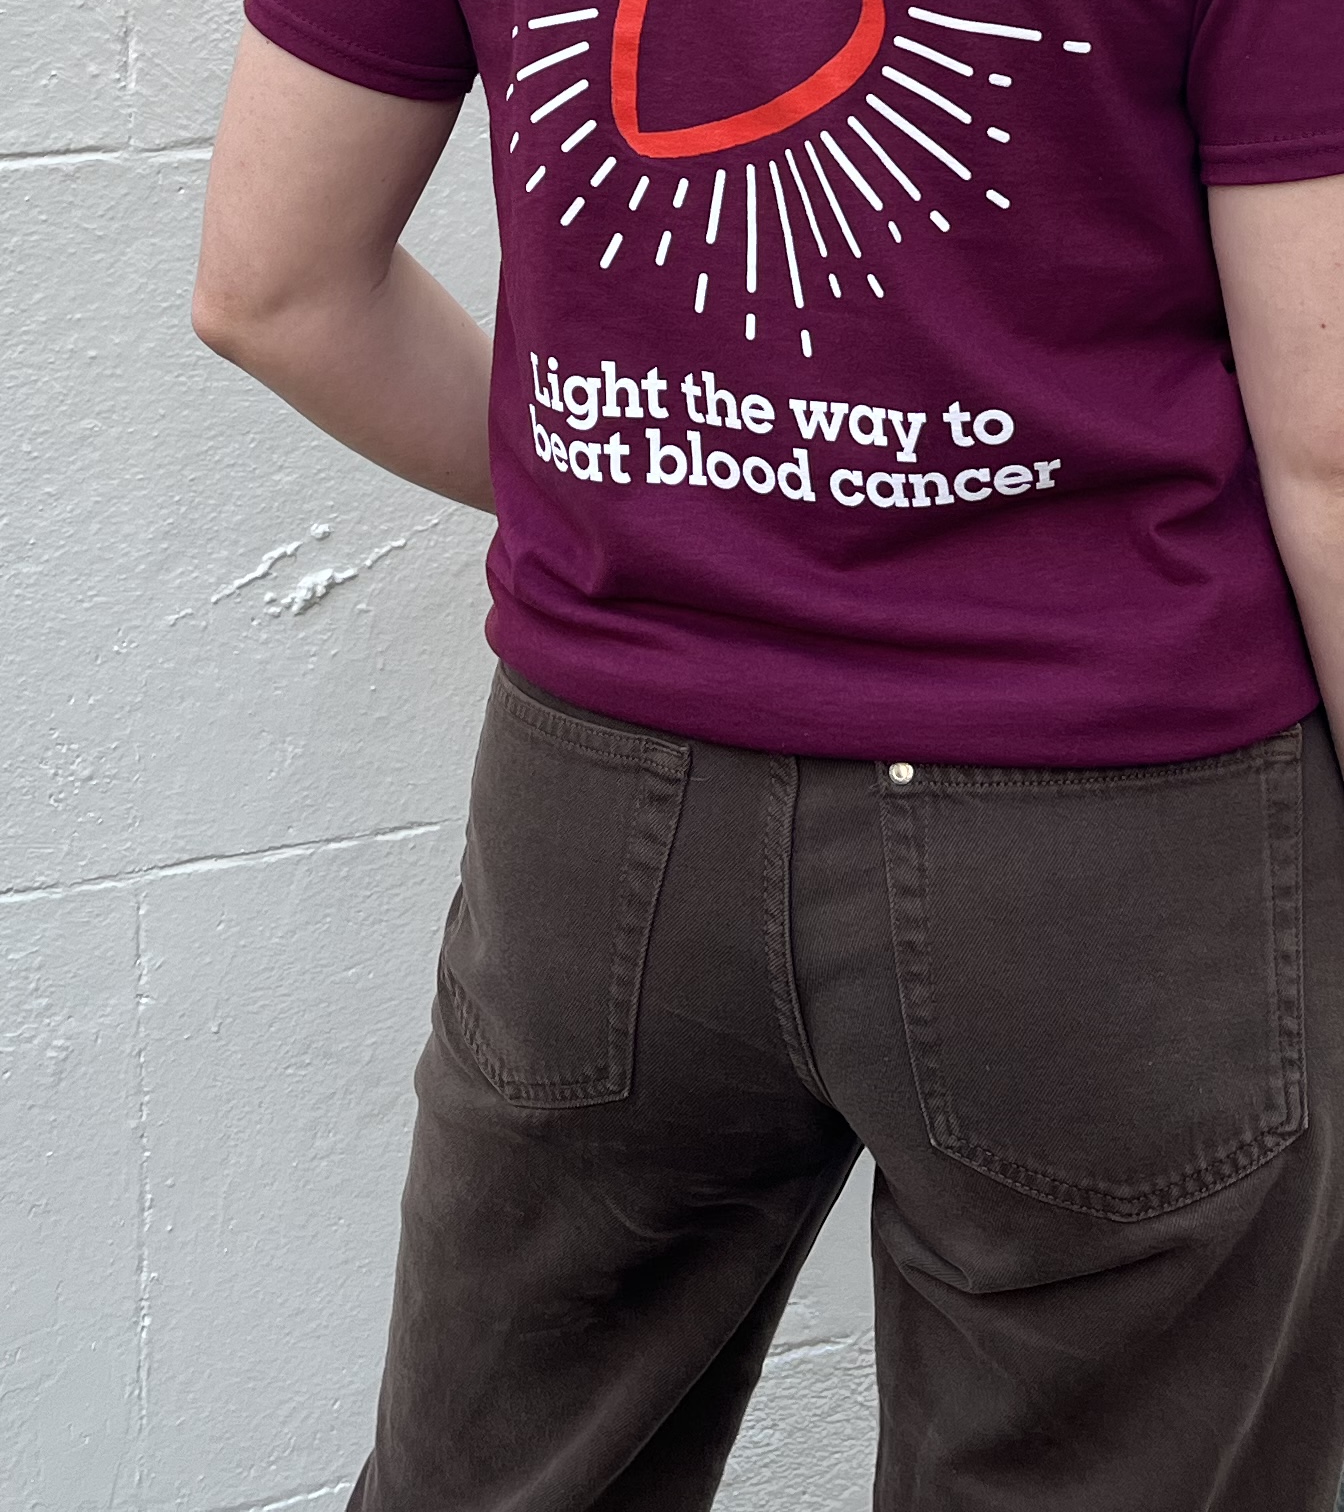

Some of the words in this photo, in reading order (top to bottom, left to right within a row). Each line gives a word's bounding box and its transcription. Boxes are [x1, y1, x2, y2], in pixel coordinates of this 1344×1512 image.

[529, 352, 668, 430] Light
[681, 371, 775, 434] the
[789, 398, 926, 463] way
[942, 401, 1015, 448] to
[529, 404, 631, 484] beat
[645, 428, 816, 502] blood
[830, 459, 1061, 508] cancer
